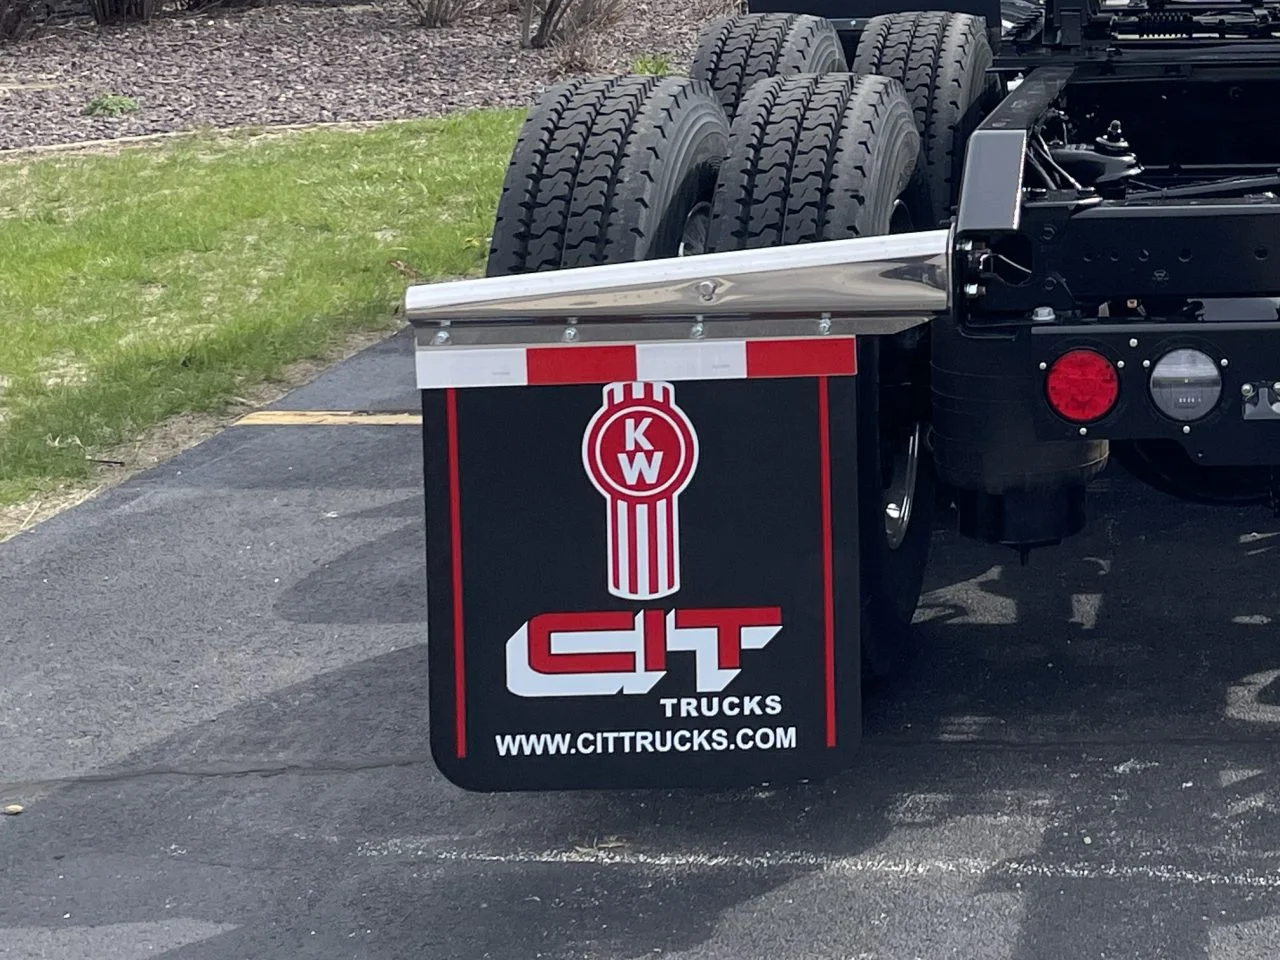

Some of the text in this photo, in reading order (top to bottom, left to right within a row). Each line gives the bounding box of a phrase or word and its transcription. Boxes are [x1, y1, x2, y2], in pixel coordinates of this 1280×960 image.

[625, 417, 654, 451] K
[617, 451, 664, 485] W
[505, 607, 784, 697] CIT
[660, 695, 782, 718] TRUCKS
[495, 727, 797, 756] WWW.CITTRUCKS.COM
